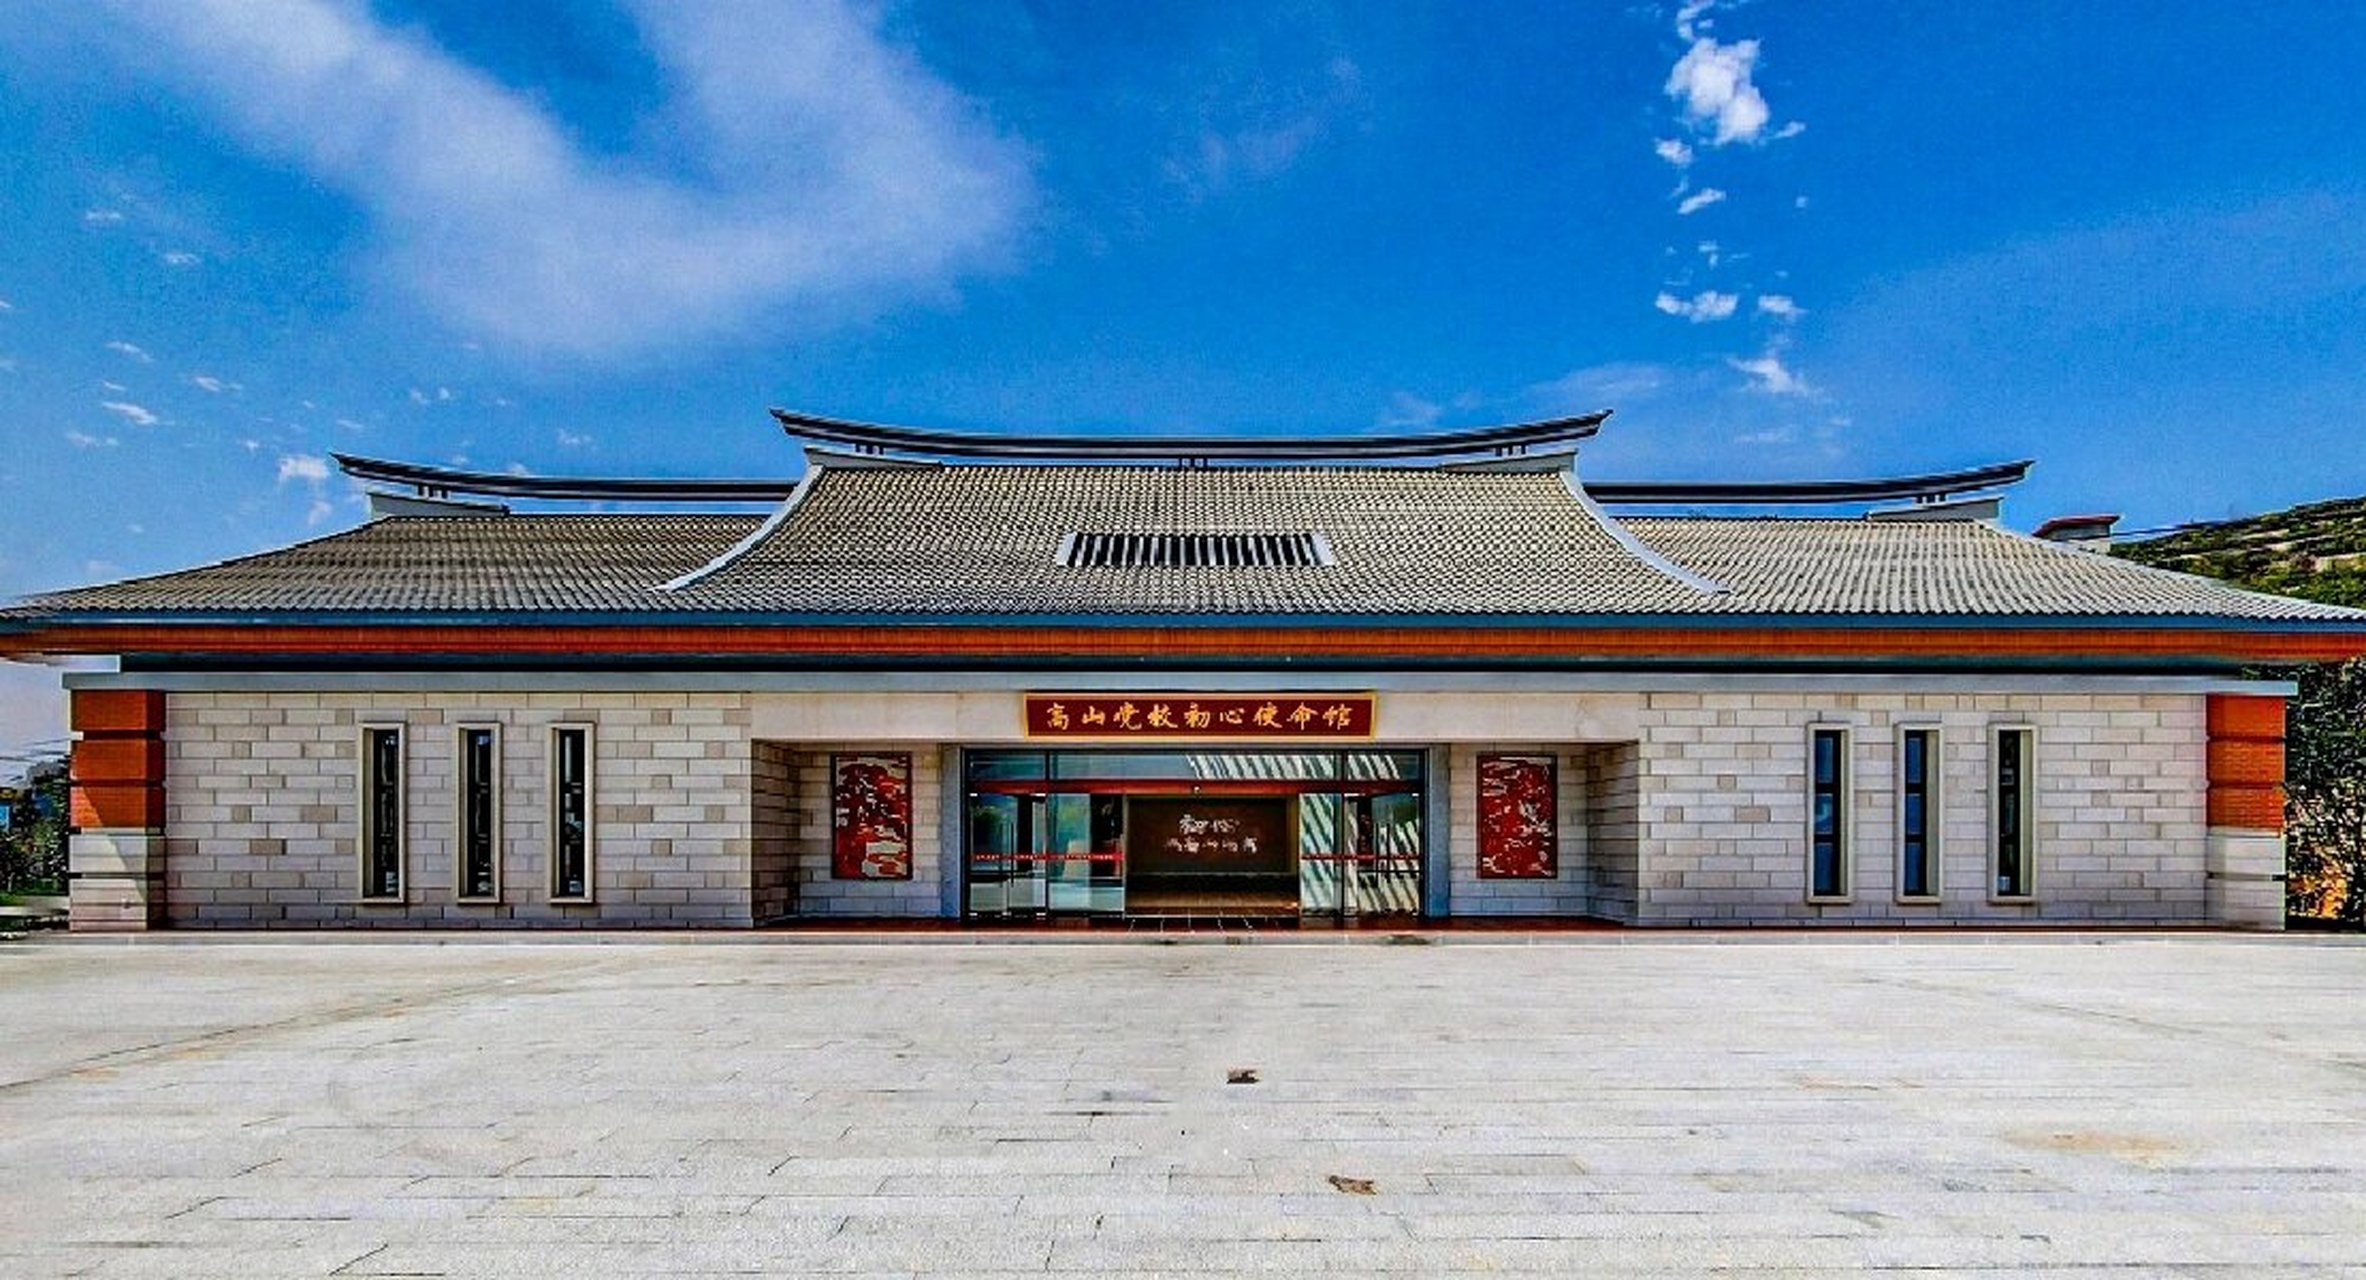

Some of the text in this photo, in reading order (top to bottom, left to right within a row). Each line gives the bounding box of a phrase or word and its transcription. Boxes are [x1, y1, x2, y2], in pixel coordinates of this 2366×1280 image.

[1046, 702, 1354, 730] 高山党校初心使命馆
